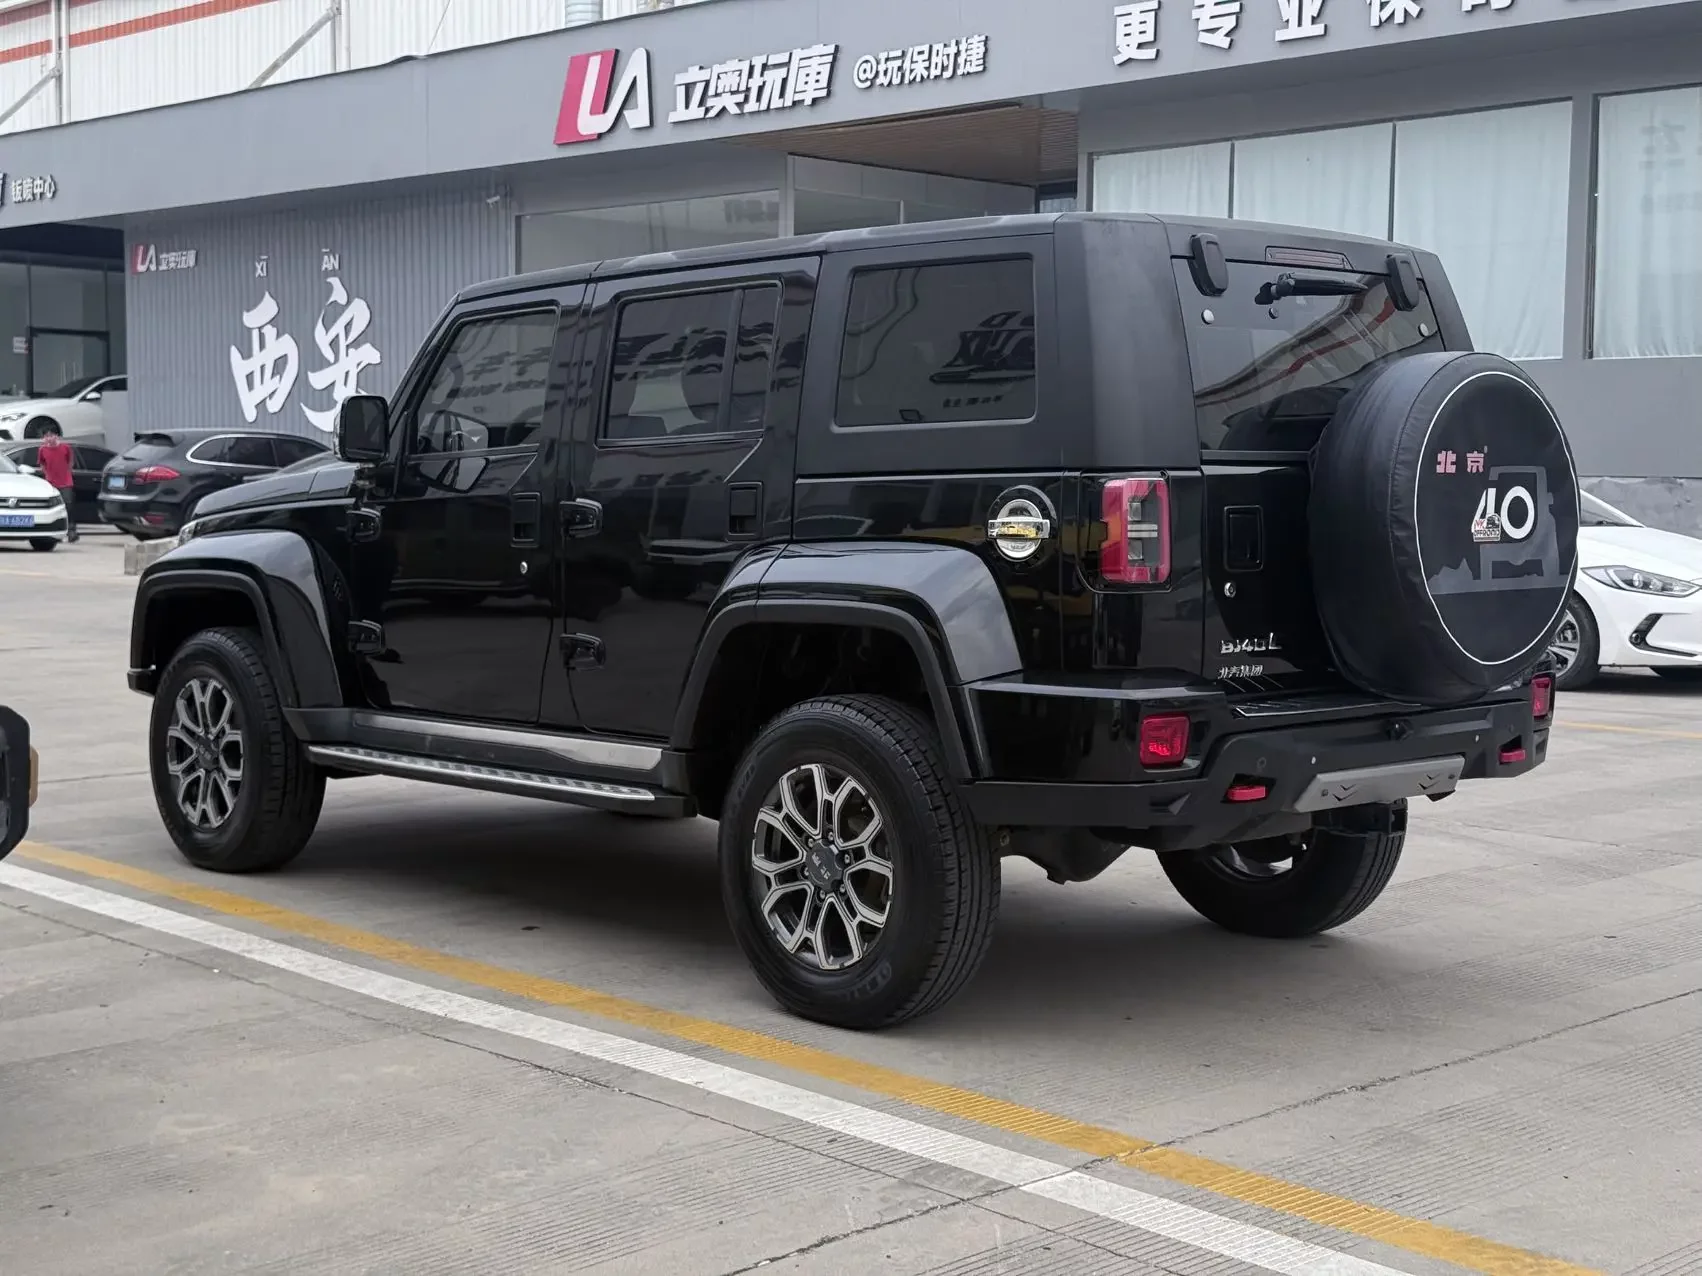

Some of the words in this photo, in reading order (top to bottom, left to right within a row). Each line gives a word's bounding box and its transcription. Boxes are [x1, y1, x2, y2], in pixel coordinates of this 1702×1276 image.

[853, 34, 987, 89] @玩保时捷
[1436, 450, 1485, 473] 北京
